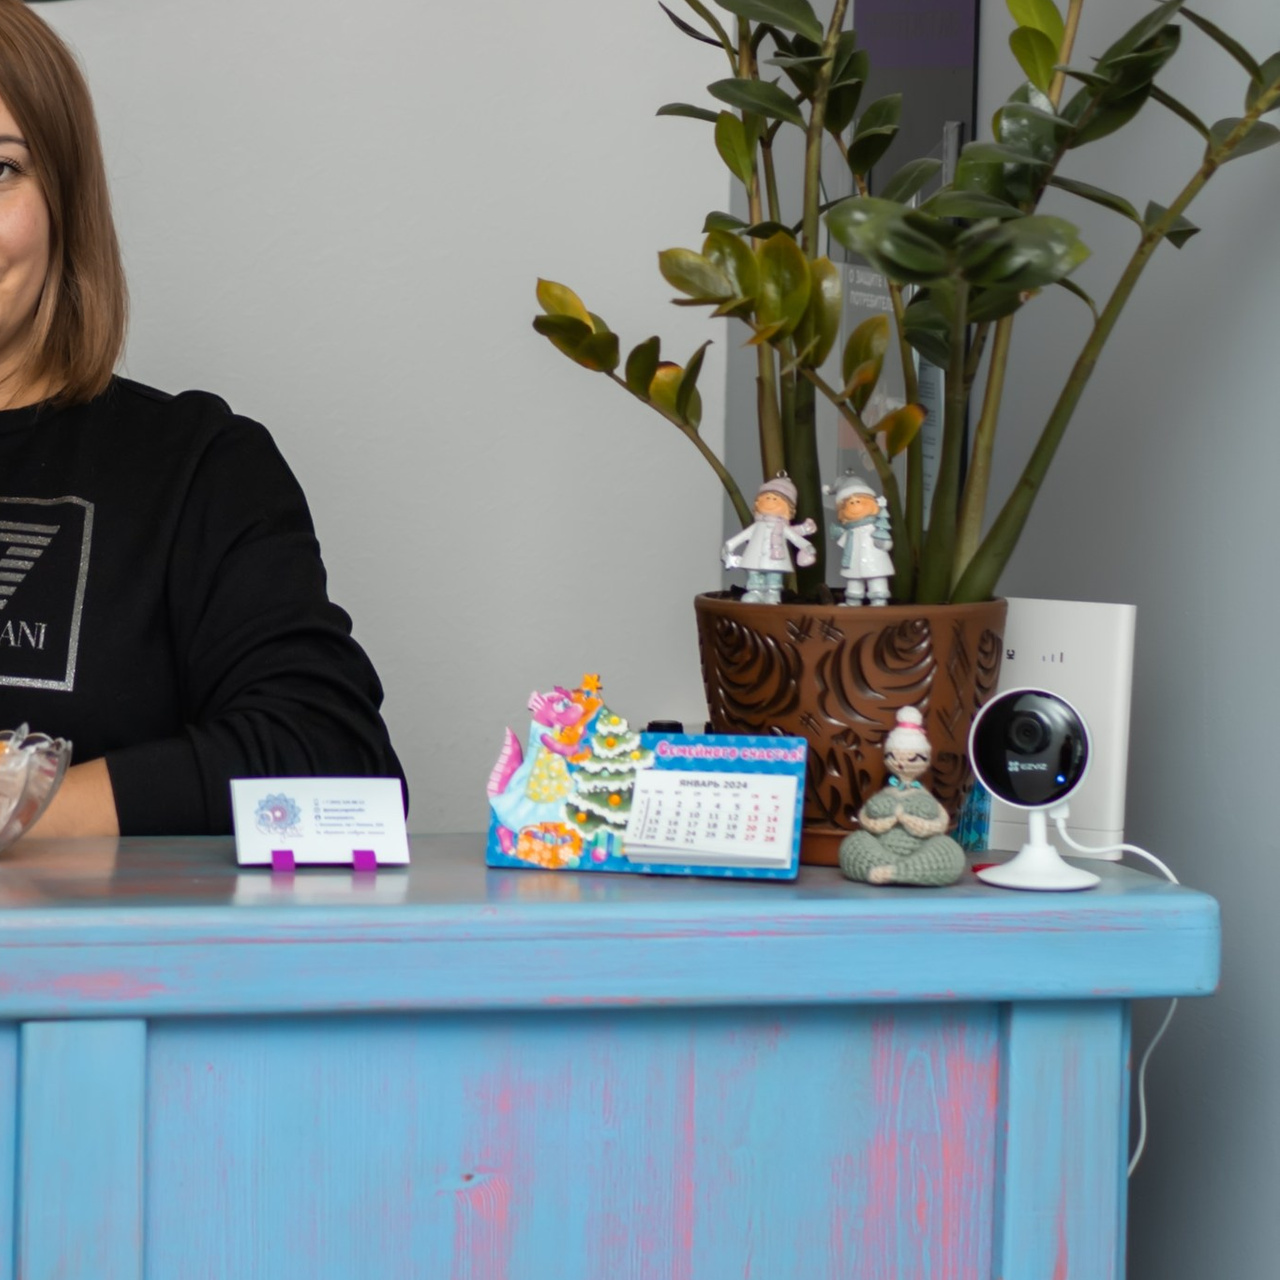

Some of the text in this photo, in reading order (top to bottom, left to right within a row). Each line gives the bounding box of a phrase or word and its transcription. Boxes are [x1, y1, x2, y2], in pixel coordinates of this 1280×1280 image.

[850, 290, 894, 312] ПОТРЕБИТЕЛ
[679, 779, 748, 789] ЯНВАРЬ 2024
